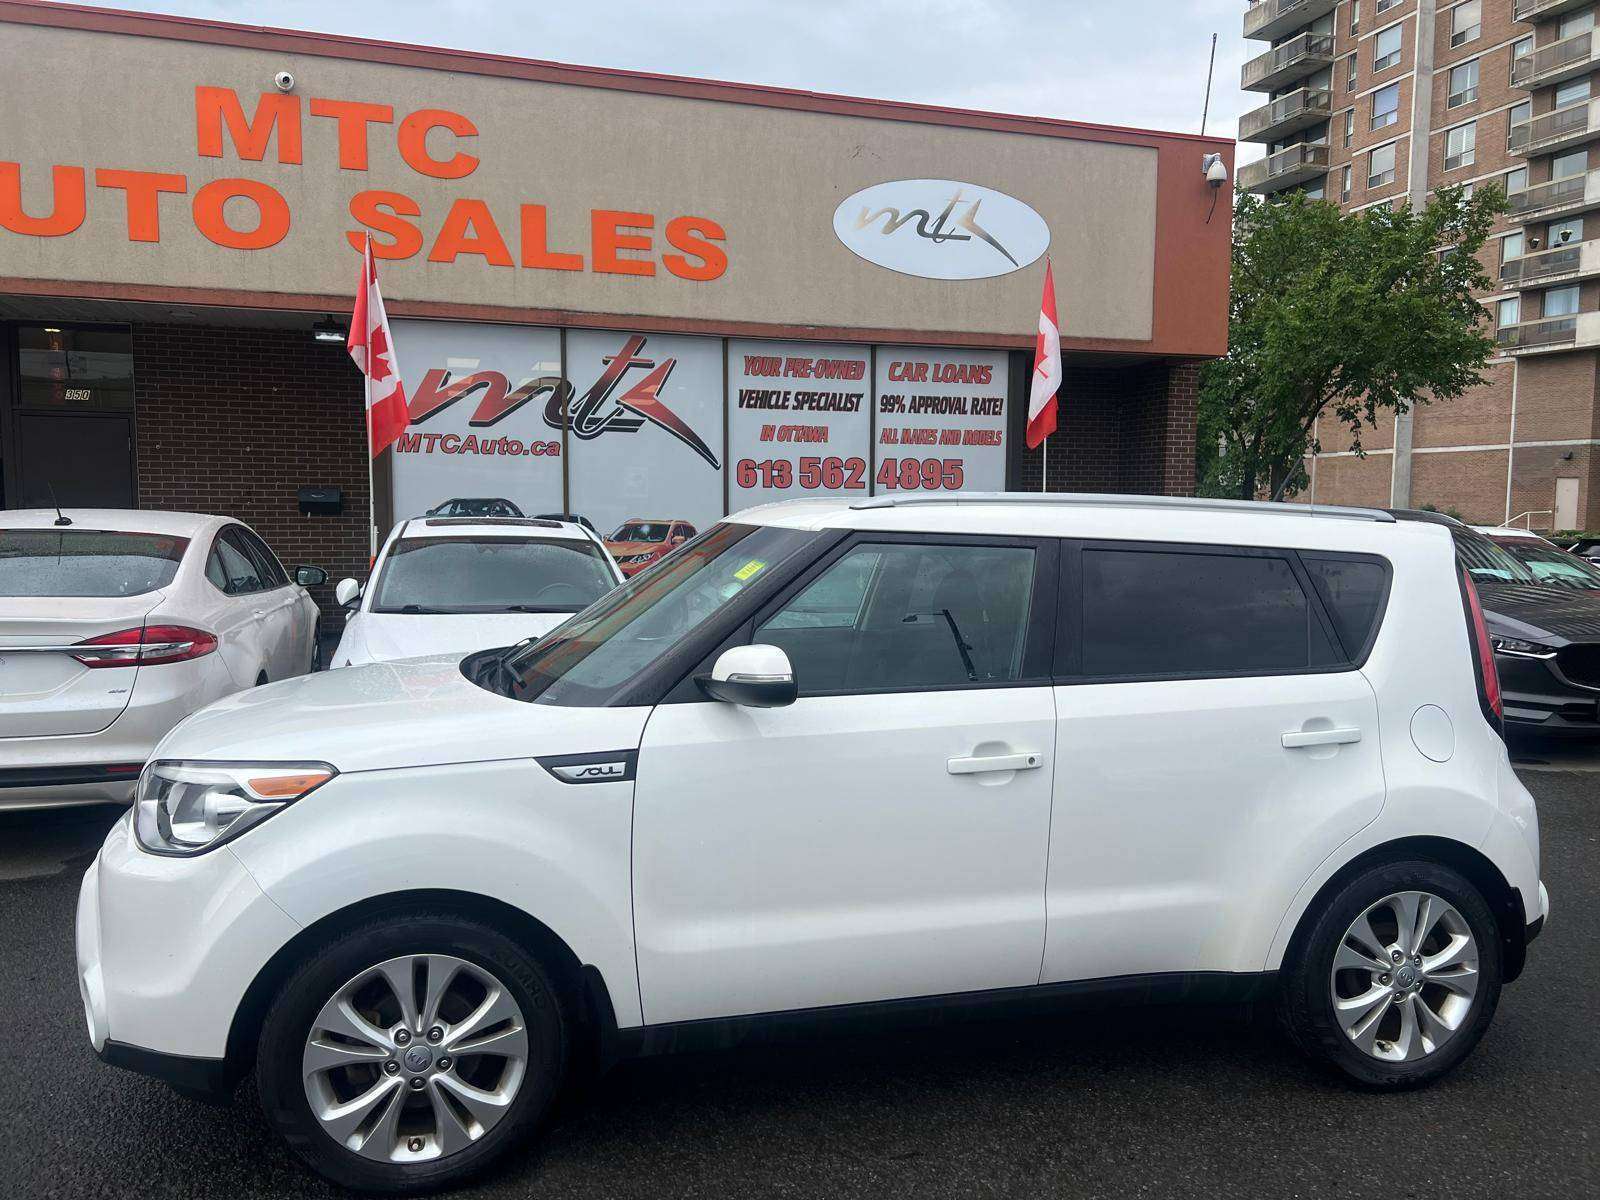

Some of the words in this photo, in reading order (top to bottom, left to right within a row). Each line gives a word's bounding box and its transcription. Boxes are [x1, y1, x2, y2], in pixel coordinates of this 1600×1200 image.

[195, 86, 480, 179] MTC
[346, 190, 728, 281] SALES
[744, 356, 781, 378] YOUR
[784, 358, 866, 381] PRE-OWNED
[888, 362, 929, 383] CAR
[931, 363, 993, 385] LOANS
[65, 390, 90, 400] 350
[738, 389, 791, 412] VEHICLE
[792, 391, 864, 413] SPECIALIST
[880, 394, 906, 414] 99%
[908, 396, 968, 416] APPROVAL
[970, 398, 1004, 416] RATE!
[396, 433, 560, 457] MTCAuto.ca
[759, 425, 775, 442] IN
[777, 425, 829, 443] OTTAWA
[879, 428, 899, 445] ALL
[900, 428, 937, 446] MAKES
[938, 429, 961, 446] AND
[962, 430, 1002, 447] MODELS
[736, 458, 793, 489] 613
[799, 456, 866, 489] 562
[876, 458, 964, 490] 4895
[576, 766, 622, 777] SOUL
